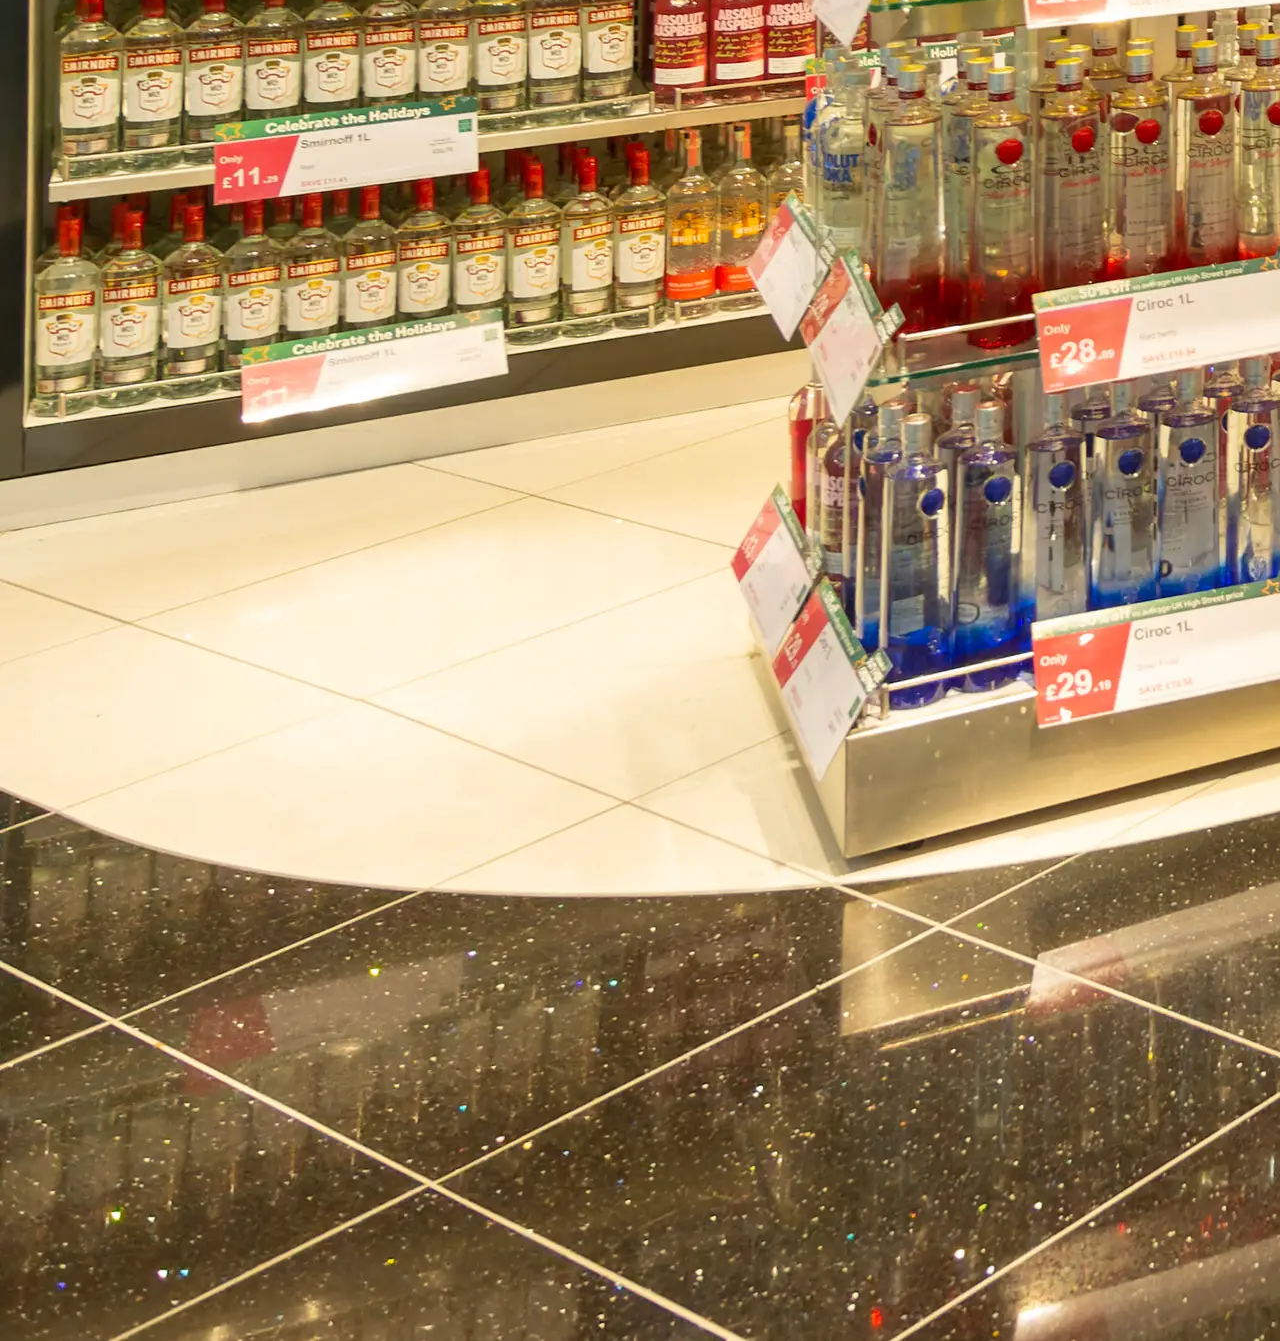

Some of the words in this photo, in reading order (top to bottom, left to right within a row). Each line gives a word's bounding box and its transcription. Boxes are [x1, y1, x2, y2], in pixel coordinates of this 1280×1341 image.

[657, 12, 704, 25] ABSOLUT
[64, 59, 117, 72] SMIRNOFF
[264, 116, 339, 135] Celebrate
[341, 114, 366, 125] the
[369, 105, 431, 122] Holidays
[300, 134, 354, 149] Smirnoff
[358, 133, 371, 143] 1L
[220, 155, 244, 165] Only
[623, 217, 665, 232] SMIRNOFF
[39, 294, 93, 309] SMIRNOFF
[1136, 297, 1174, 313] Ciroc
[1178, 294, 1194, 306] 1L
[292, 335, 366, 356] Celebrate
[369, 331, 393, 343] the
[396, 318, 456, 339] Holidays
[1044, 323, 1071, 336] Only
[1134, 626, 1173, 641] Ciroc
[1177, 622, 1193, 634] 1L
[1040, 653, 1067, 667] Only
[1046, 669, 1111, 702] £29.19
